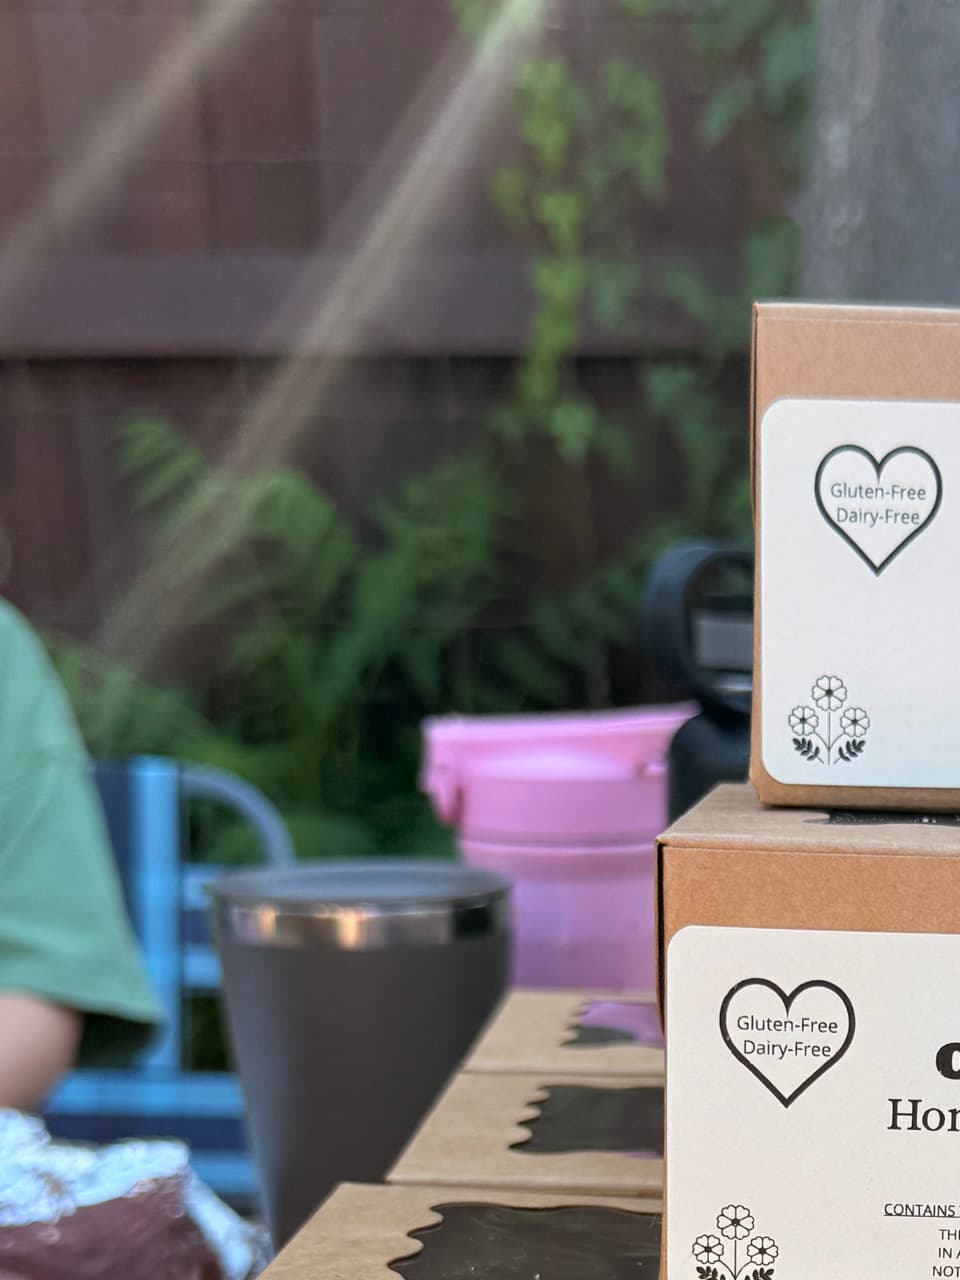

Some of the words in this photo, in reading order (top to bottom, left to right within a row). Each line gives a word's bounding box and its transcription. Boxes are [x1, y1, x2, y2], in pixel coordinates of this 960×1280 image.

[830, 481, 926, 501] Gluten-Free
[836, 506, 920, 528] Dairy-Free
[737, 1014, 838, 1034] Gluten-Free
[743, 1039, 832, 1061] Dairy-Free
[884, 1202, 956, 1216] CONTAINS
[938, 1247, 952, 1259] IN
